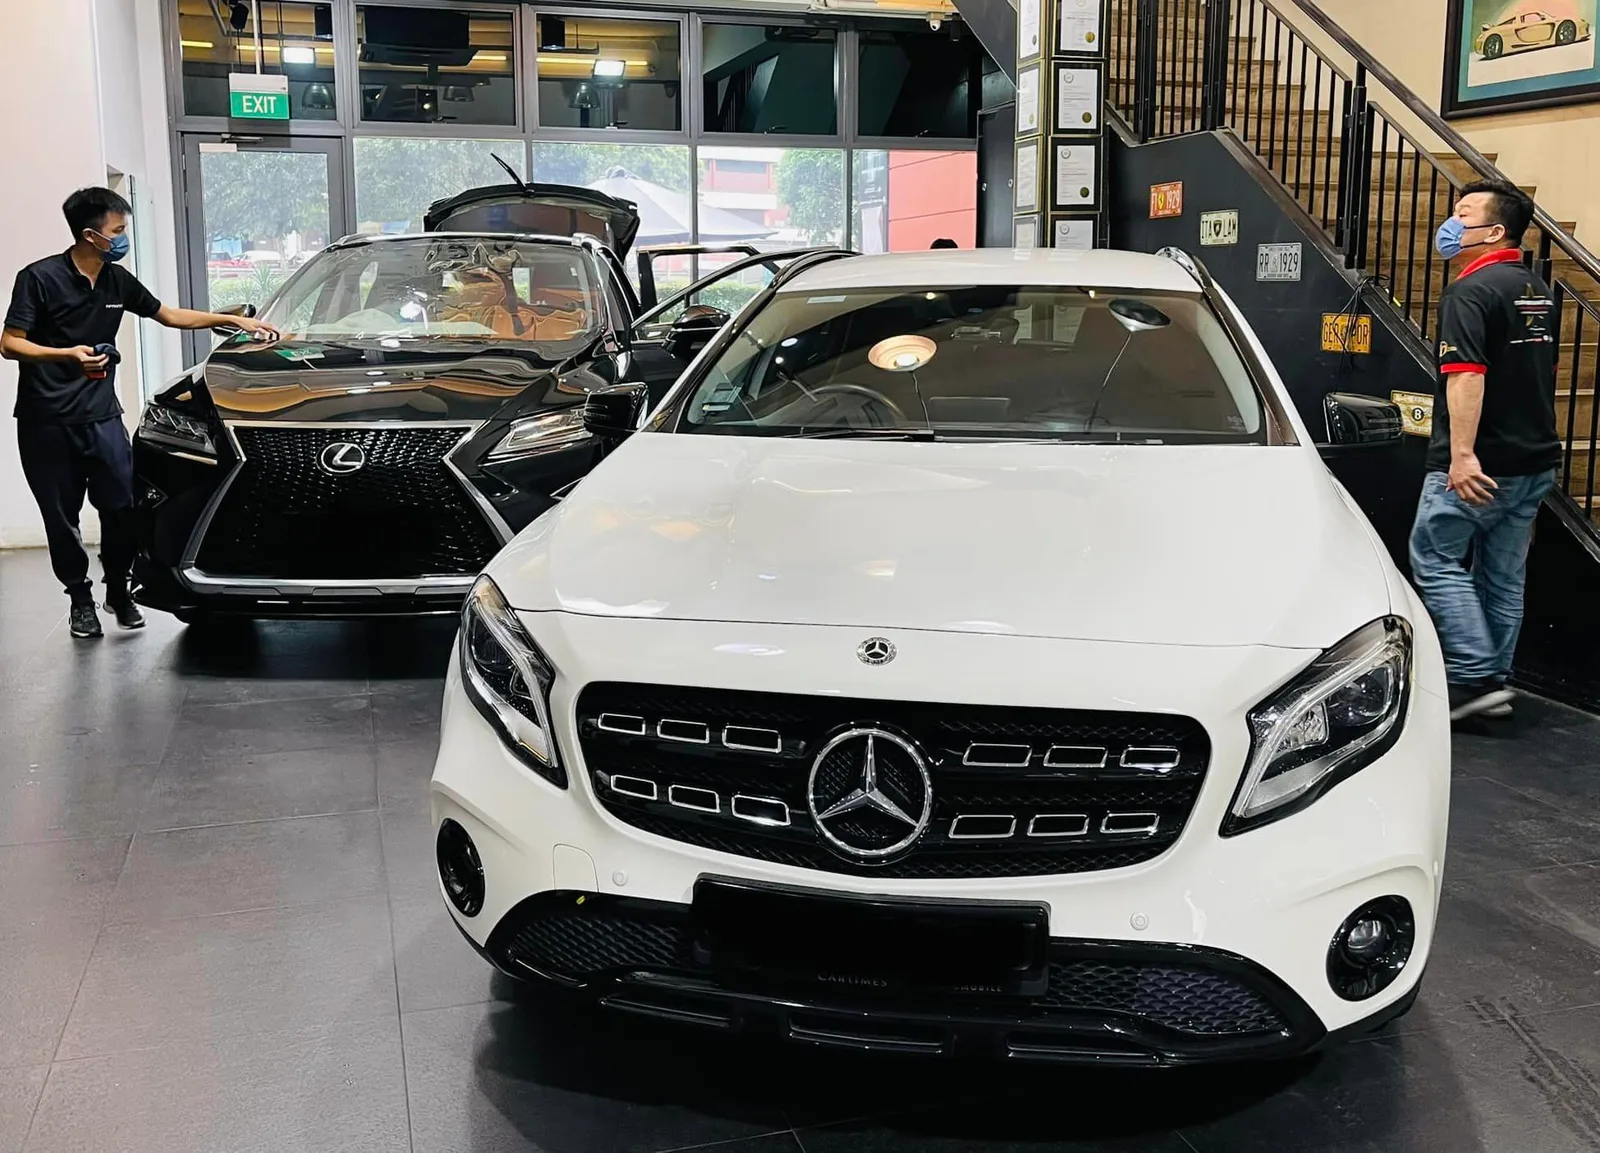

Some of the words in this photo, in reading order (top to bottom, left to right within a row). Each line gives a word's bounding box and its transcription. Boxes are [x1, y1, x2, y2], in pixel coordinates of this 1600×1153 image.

[242, 95, 276, 114] EXIT
[1166, 189, 1181, 209] 1929
[1260, 252, 1270, 272] RR
[1280, 252, 1299, 272] 1929
[1323, 322, 1340, 343] GER
